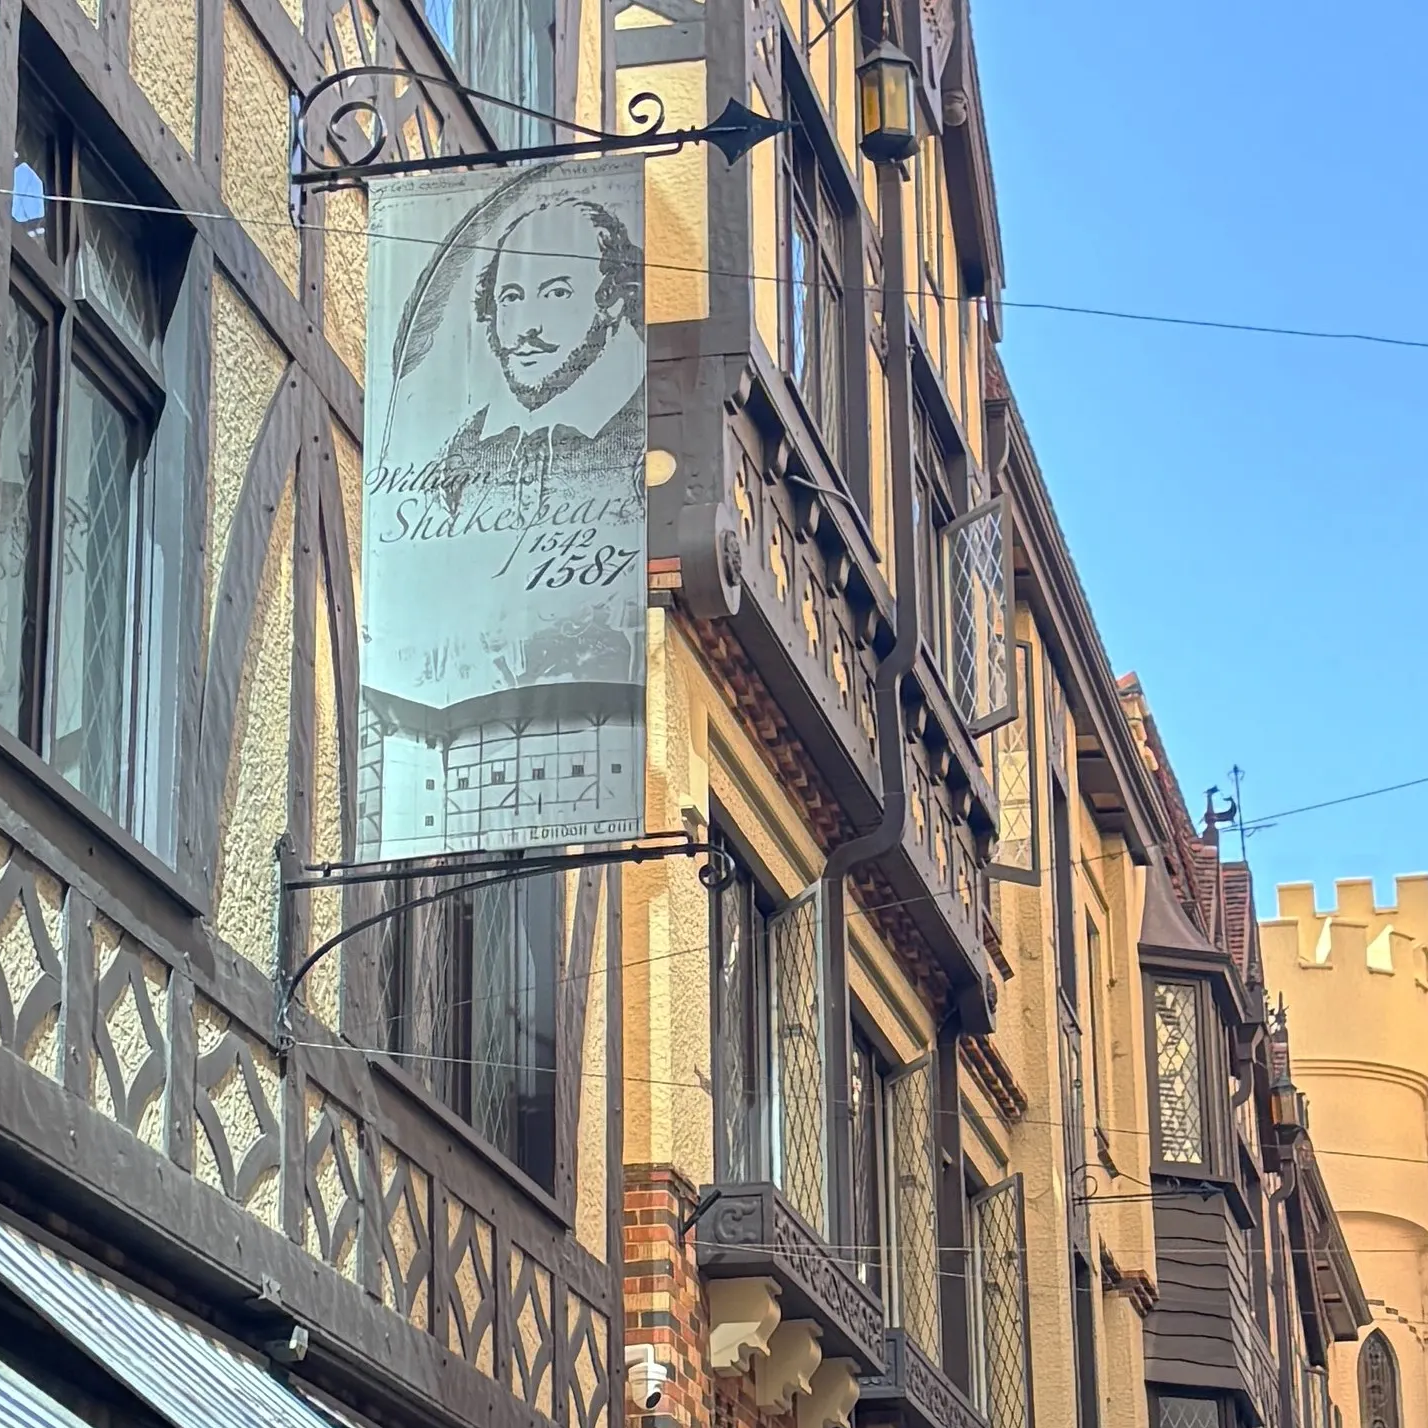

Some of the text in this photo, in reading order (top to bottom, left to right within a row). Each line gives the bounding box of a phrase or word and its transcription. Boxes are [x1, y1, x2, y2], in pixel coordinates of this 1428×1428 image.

[365, 462, 491, 495] William
[379, 491, 639, 579] Shakespeare
[528, 528, 597, 556] 1542
[525, 545, 641, 591] 1587
[529, 823, 588, 841] London
